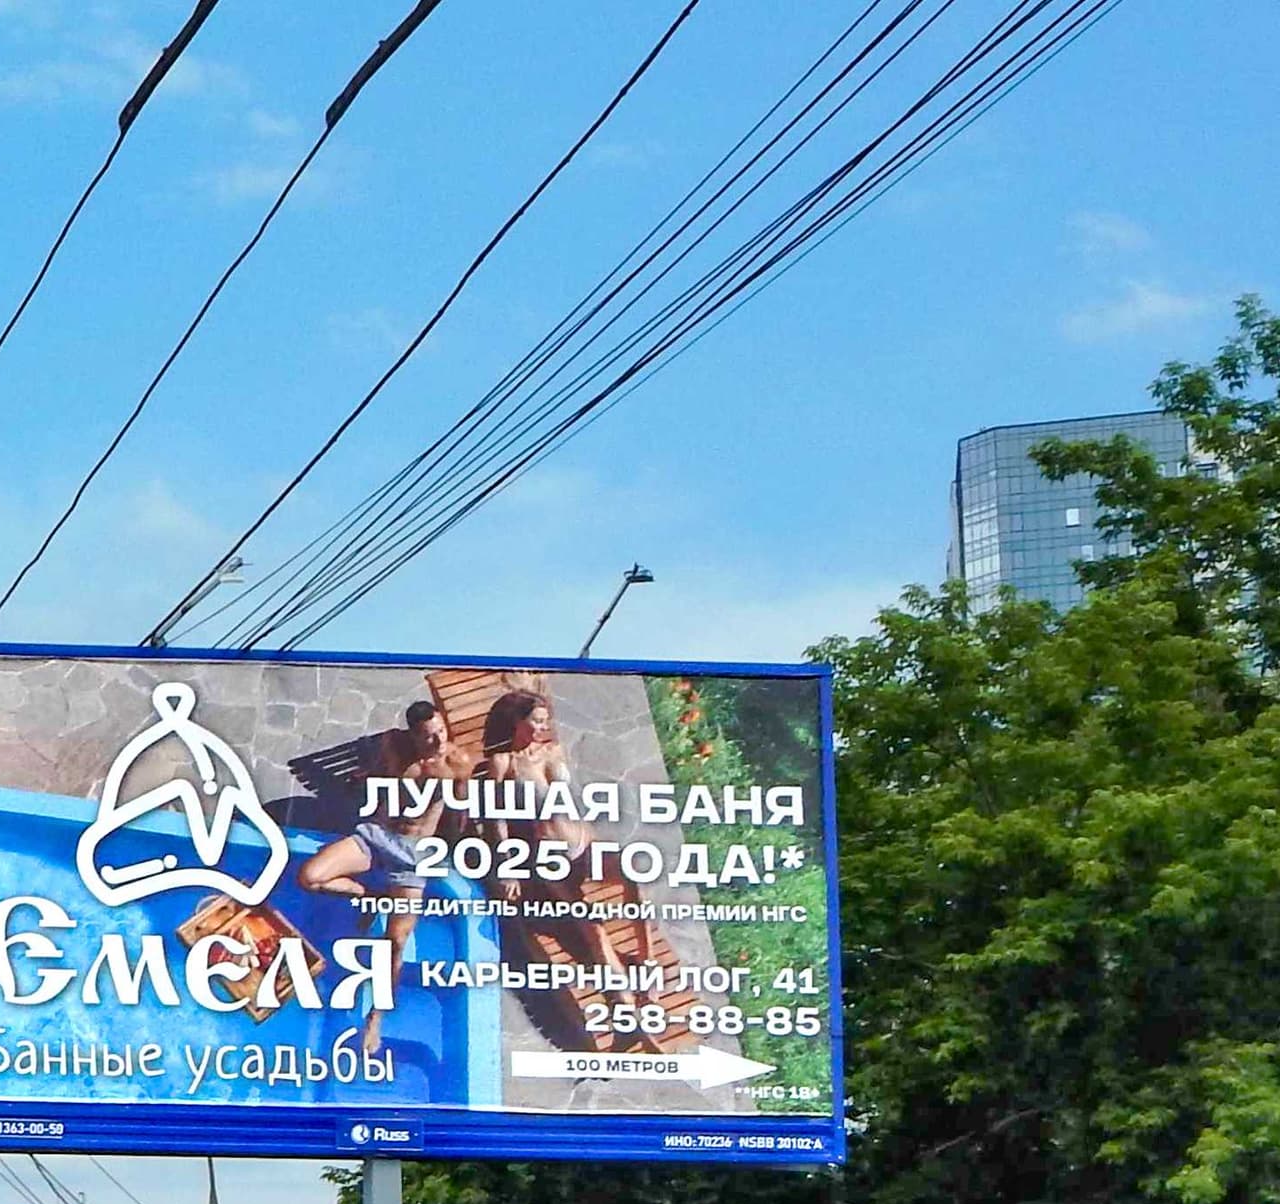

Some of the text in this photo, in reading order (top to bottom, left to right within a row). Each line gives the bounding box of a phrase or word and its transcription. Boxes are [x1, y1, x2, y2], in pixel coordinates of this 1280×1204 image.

[359, 776, 805, 826] ЛУЧШАЯ БАНЯ
[414, 837, 572, 881] 2025
[523, 899, 656, 921] НАРОДНОЙ
[662, 904, 757, 922] ПРЕМИИ
[761, 906, 808, 923] НГС
[421, 959, 820, 998] КАРЬЕРНЫЙ ЛОГ, 41
[584, 1002, 821, 1037] 258-88-85
[184, 1026, 396, 1095] усадьбы
[566, 1058, 680, 1074] 100 МЕТРОВ
[373, 1127, 410, 1141] Russ
